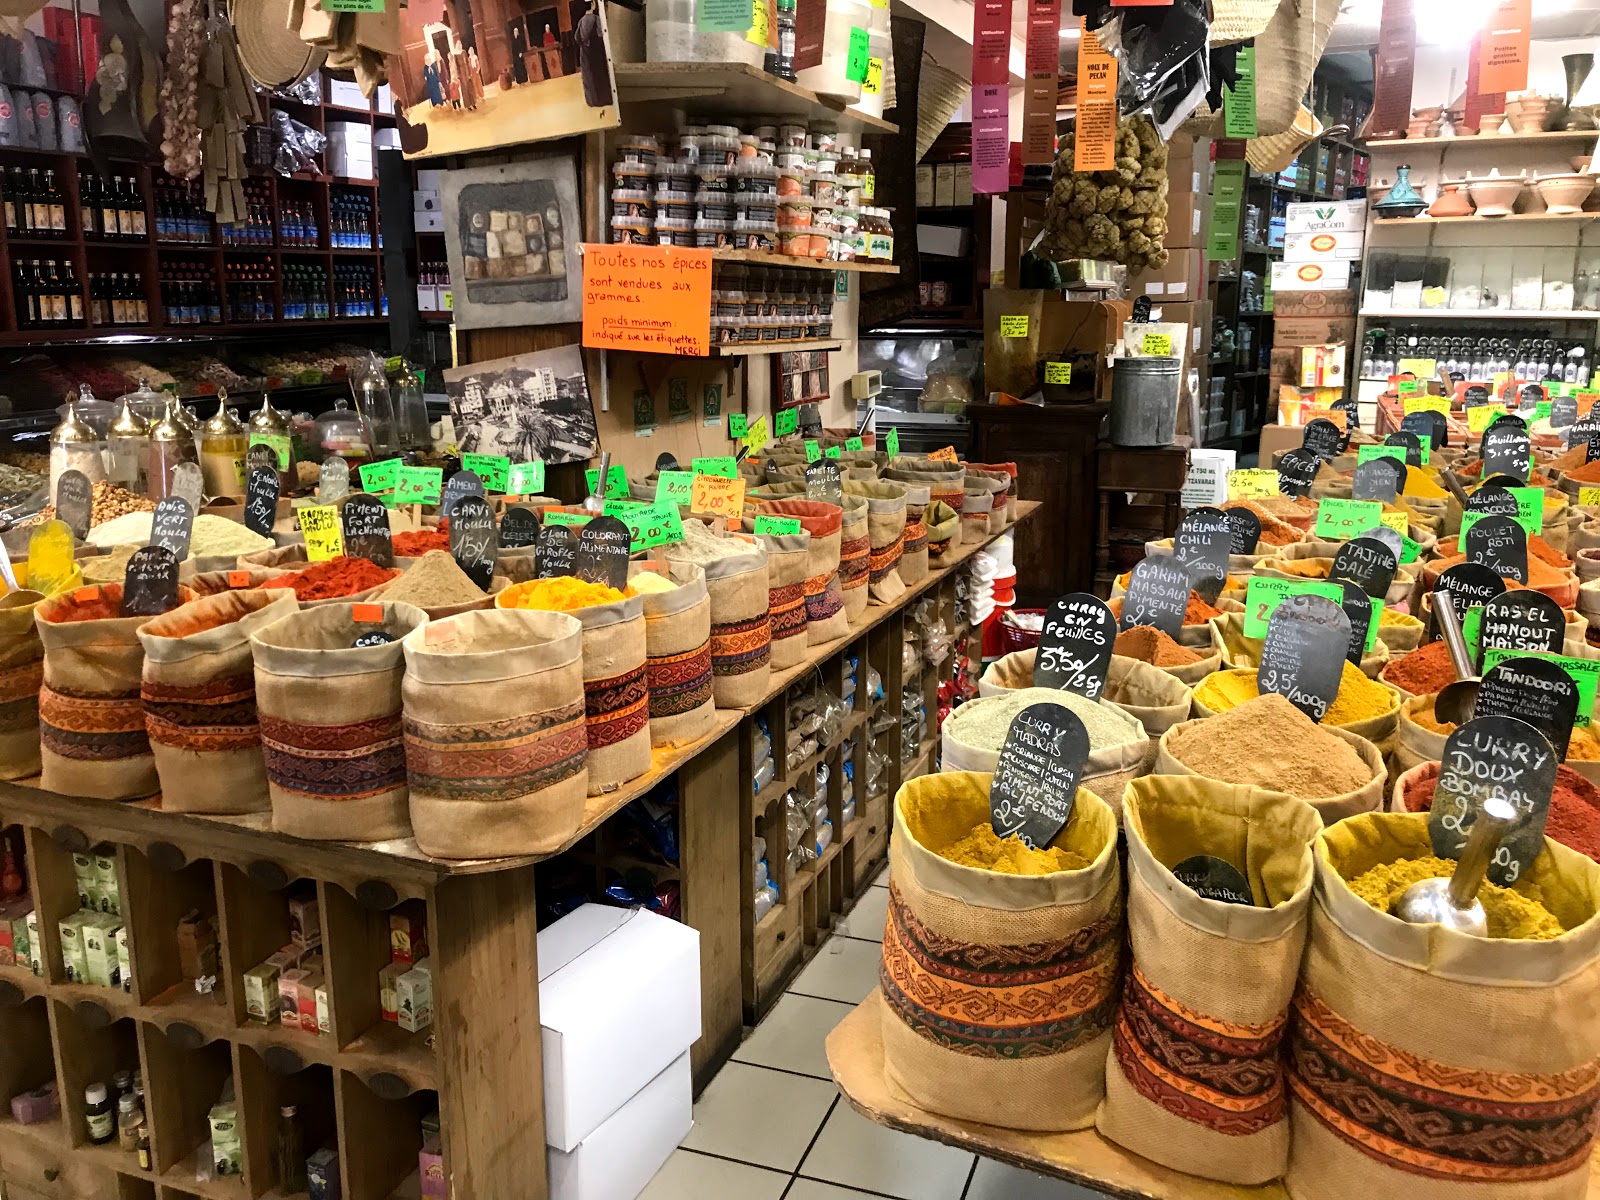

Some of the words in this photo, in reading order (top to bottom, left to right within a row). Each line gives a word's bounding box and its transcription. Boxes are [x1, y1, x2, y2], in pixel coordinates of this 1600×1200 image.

[1305, 221, 1344, 231] AgraCom
[590, 251, 637, 268] Toutes
[642, 259, 665, 269] nos
[672, 257, 707, 273] épices
[590, 275, 613, 287] sont
[618, 278, 662, 290] vendues
[672, 282, 691, 291] aux
[602, 315, 628, 329] poids
[592, 330, 623, 342] indiqué
[643, 332, 653, 341] les
[697, 492, 723, 508] 2,00
[348, 516, 380, 527] FORT
[1182, 518, 1230, 533] MÉLANGE
[1324, 513, 1354, 526] 2,00
[581, 529, 630, 541] COLORANT
[631, 526, 662, 545] 2,00
[1335, 555, 1373, 579] SALÉ
[1131, 579, 1187, 602] MASSALA
[1439, 574, 1494, 598] MÉLANGE
[1485, 603, 1522, 619] RAS
[1527, 607, 1550, 622] EL
[1485, 621, 1556, 641] HANOUT
[1018, 710, 1067, 742] CURRY
[1013, 726, 1061, 757] MADRAS
[1449, 750, 1524, 784] DOUX
